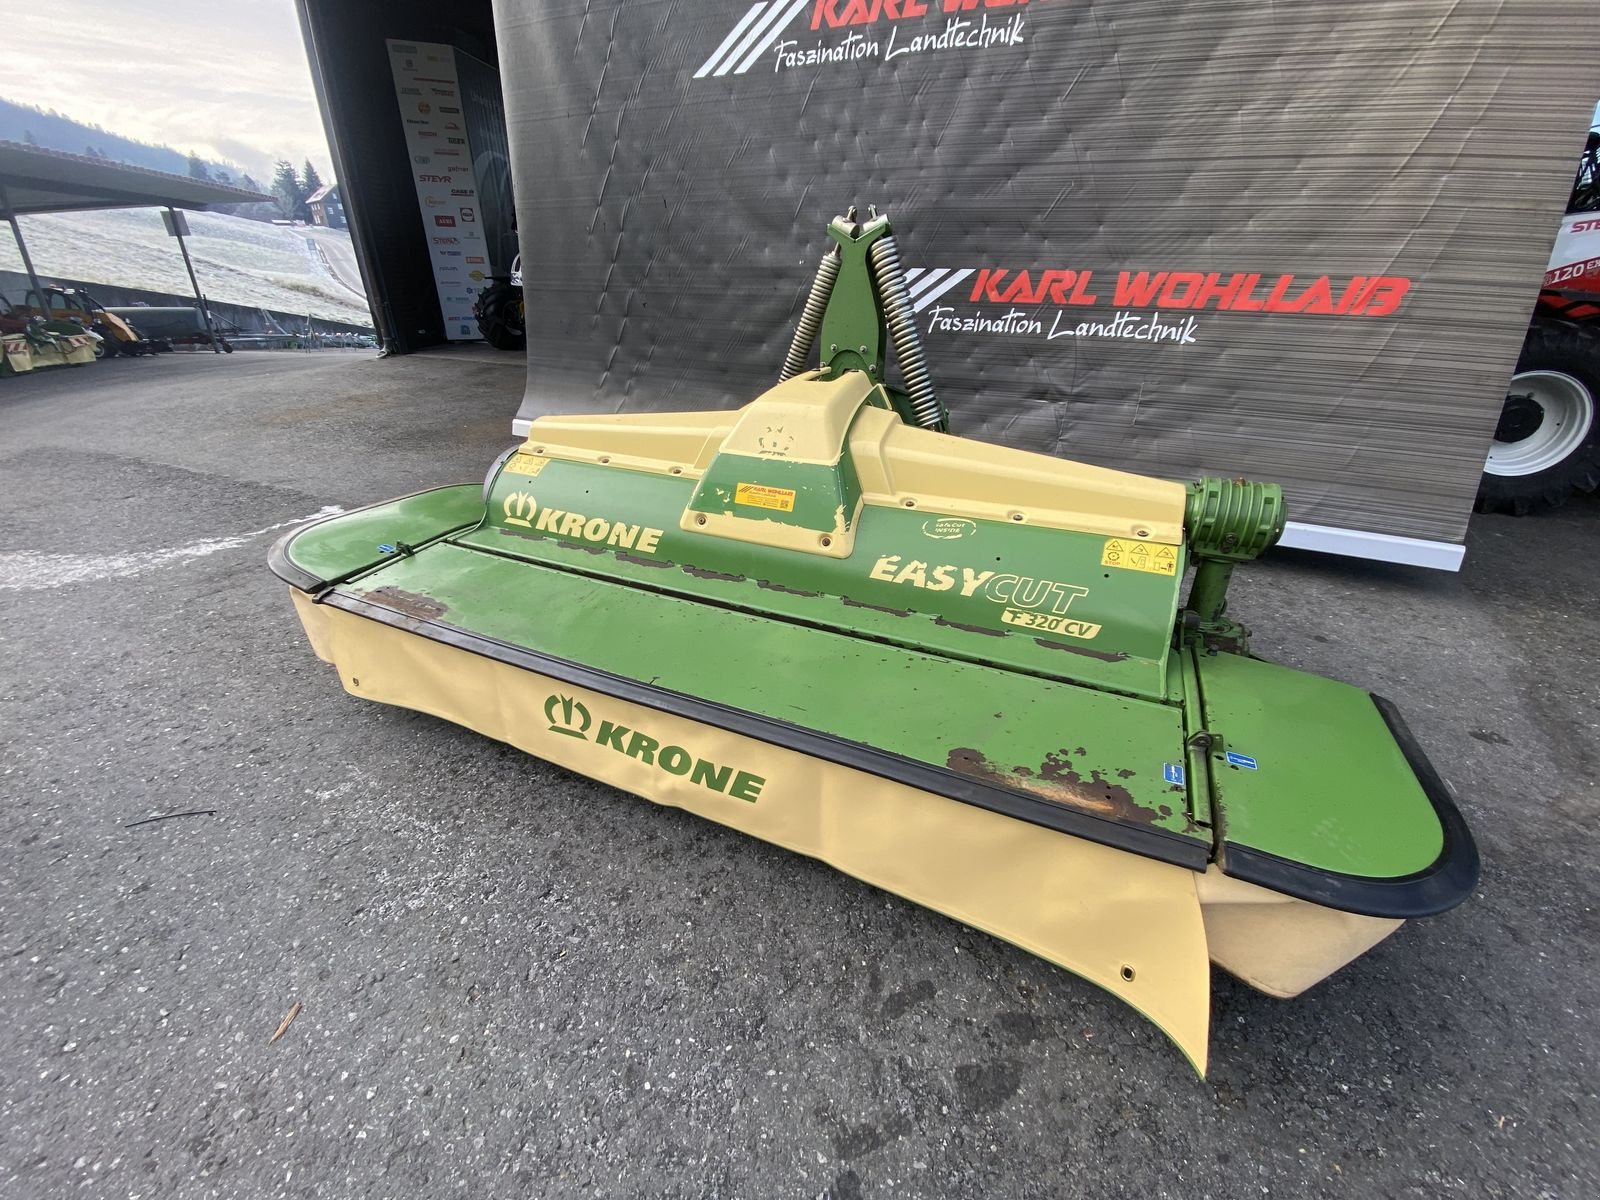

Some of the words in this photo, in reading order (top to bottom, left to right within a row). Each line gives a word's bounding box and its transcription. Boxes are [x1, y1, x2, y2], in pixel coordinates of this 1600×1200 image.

[774, 31, 879, 72] Faszination
[885, 13, 1025, 61] Landtechnik
[419, 175, 452, 183] STEYR
[969, 269, 1097, 305] KARL
[1112, 271, 1411, 317] WOHLLAIB
[928, 305, 1042, 336] Faszination
[1047, 309, 1198, 345] Landtechnik
[535, 507, 665, 554] KRONE
[1025, 613, 1061, 631] 320
[1064, 621, 1093, 637] CV
[595, 720, 767, 804] KRONE
